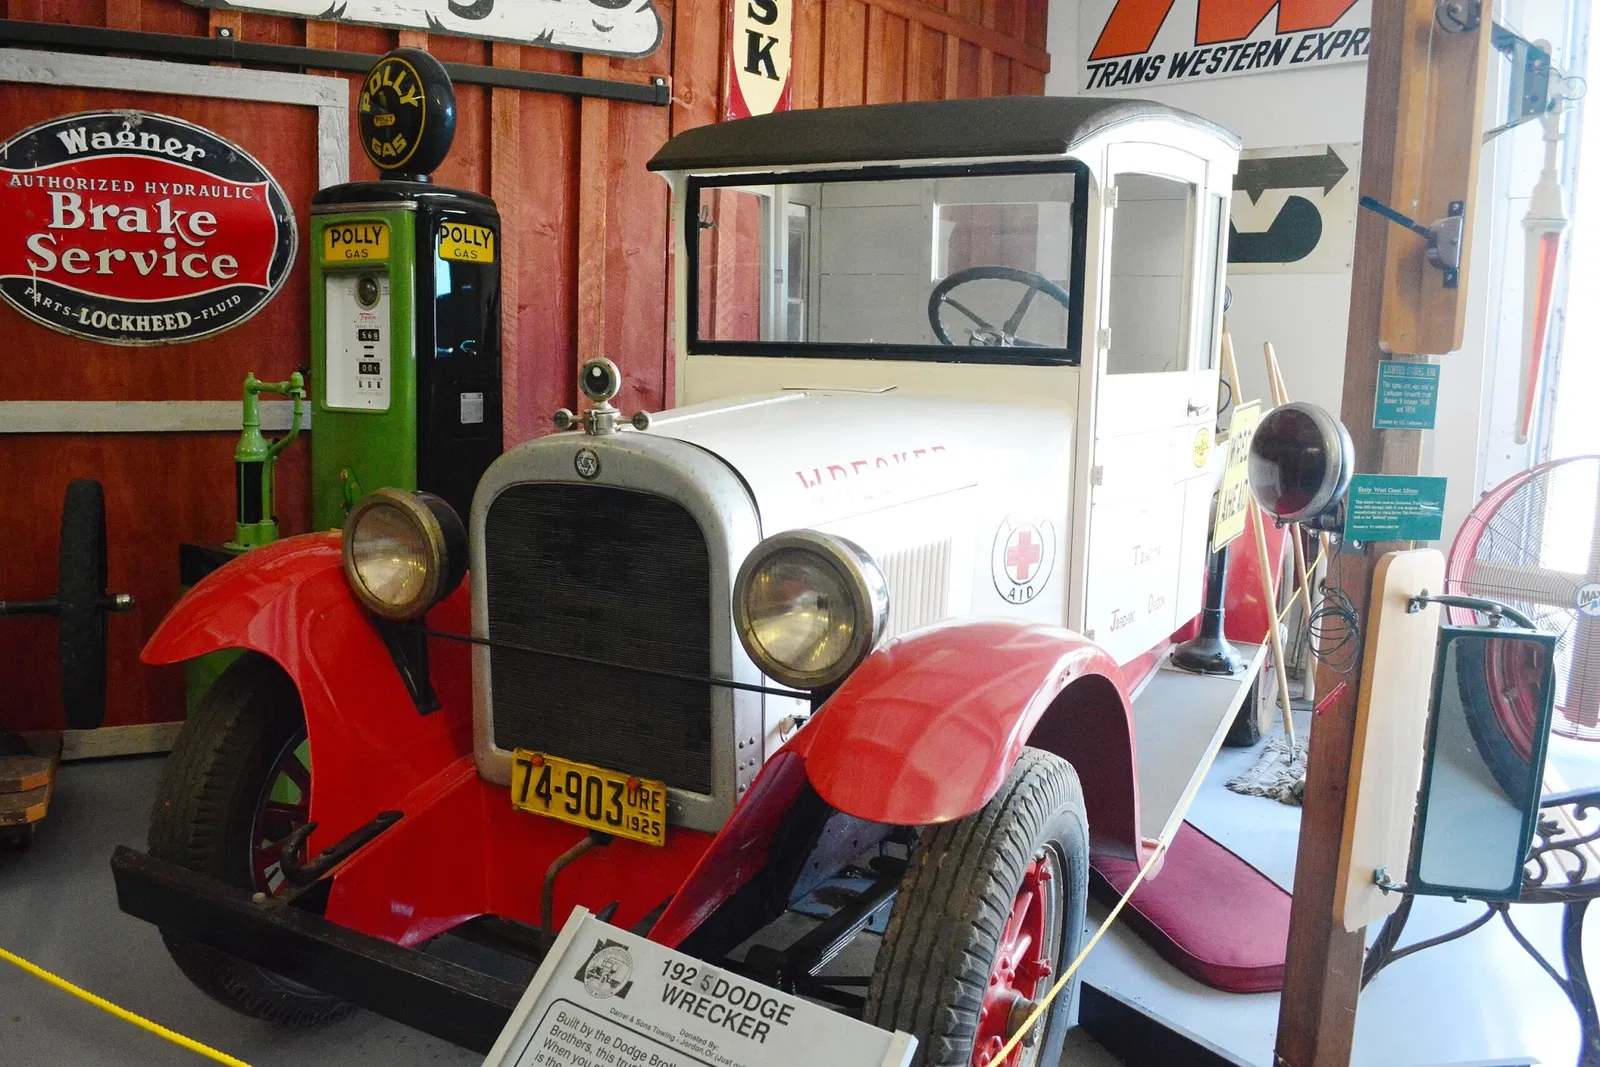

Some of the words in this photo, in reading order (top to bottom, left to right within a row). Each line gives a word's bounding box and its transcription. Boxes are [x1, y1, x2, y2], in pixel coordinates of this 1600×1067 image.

[1086, 54, 1166, 90] TRANS
[1167, 36, 1292, 80] WESTERN
[1290, 27, 1370, 64] EXPR
[362, 65, 418, 112] POLLY
[57, 121, 206, 163] Wagner
[371, 132, 407, 157] GAS
[10, 174, 135, 193] AUTHORIZED
[144, 181, 253, 199] HYDRAULIC
[47, 191, 217, 247] Brake
[330, 226, 383, 248] POLLY
[439, 225, 493, 249] POLLY
[26, 232, 239, 279] Service
[345, 248, 369, 259] GAS
[453, 248, 478, 259] GAS
[1008, 587, 1033, 602] AID
[517, 758, 624, 826] 74-903
[626, 814, 660, 837] 1925
[661, 959, 714, 992] 1925
[711, 978, 795, 1026] DODGE
[661, 983, 770, 1044] WRECKER
[556, 1011, 580, 1029] Built
[579, 1022, 594, 1037] by
[594, 1030, 611, 1045] the
[612, 1037, 648, 1061] Dodge
[635, 1018, 651, 1031] Sons
[653, 1025, 676, 1043] Towing
[679, 1028, 707, 1046] Donated
[707, 1041, 720, 1051] By:
[543, 1037, 571, 1059] When
[570, 1053, 592, 1067] you
[550, 1025, 593, 1055] Brothers,
[595, 1046, 614, 1064] this
[534, 1050, 545, 1062] is
[545, 1056, 562, 1067] the
